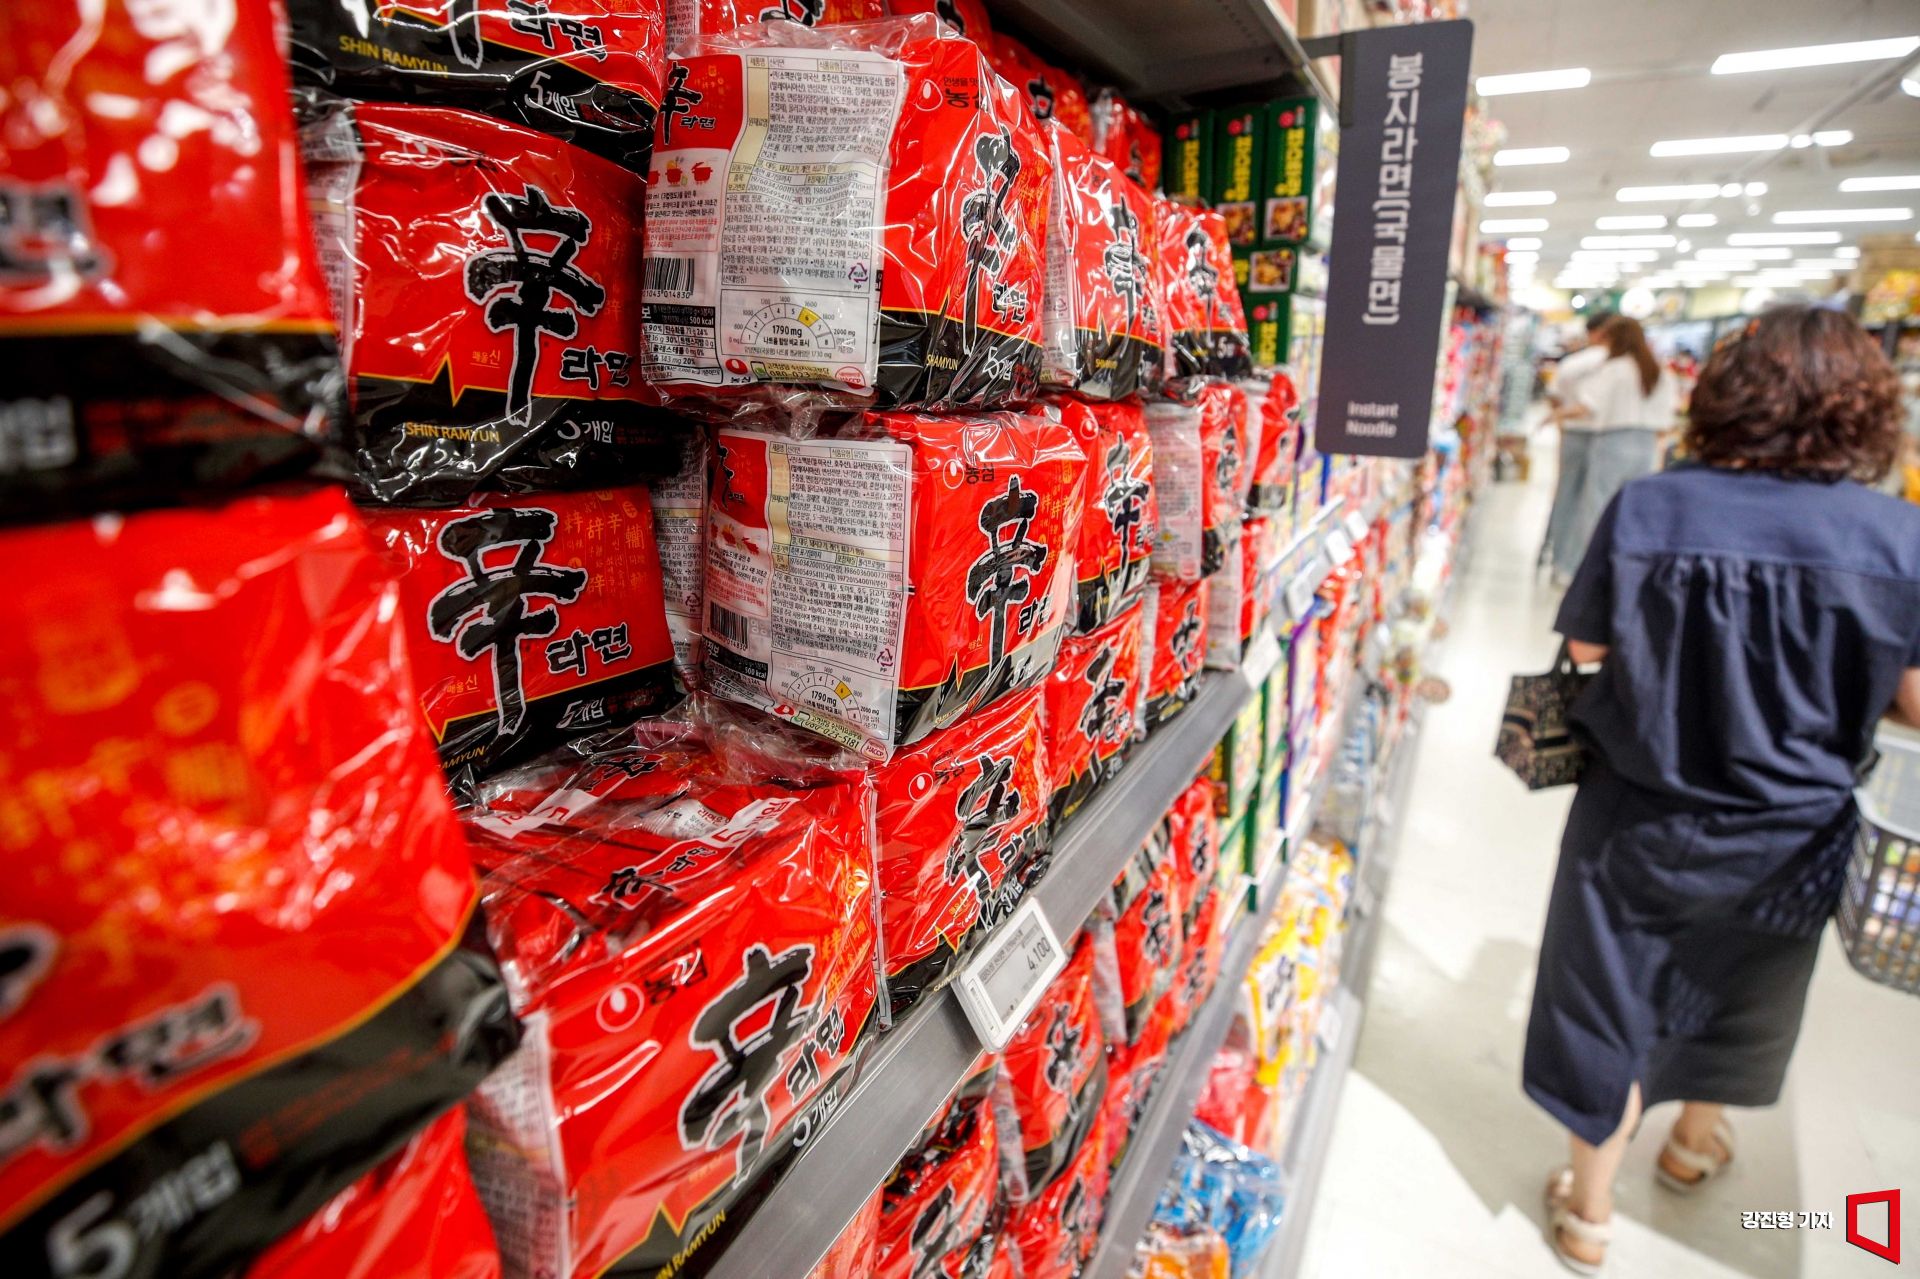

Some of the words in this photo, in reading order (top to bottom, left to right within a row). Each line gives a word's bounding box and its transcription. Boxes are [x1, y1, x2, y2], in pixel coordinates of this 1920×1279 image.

[339, 34, 379, 60] SHIN
[382, 47, 448, 79] RAMYUN
[680, 114, 716, 129] 라면
[463, 183, 606, 427] 辛
[690, 316, 701, 325] 500
[702, 317, 714, 325] kcal
[1345, 419, 1398, 438] Noodle
[1347, 401, 1398, 419] Instant
[404, 421, 439, 439] SHIN
[440, 425, 501, 445] RAMYUN
[966, 473, 1047, 680] 辛
[425, 506, 590, 735] 辛
[544, 622, 634, 676] 라면
[556, 698, 606, 731] 5개입
[678, 943, 815, 1190] 辛
[785, 1001, 846, 1106] 라면
[673, 1207, 728, 1275] RAMYUN
